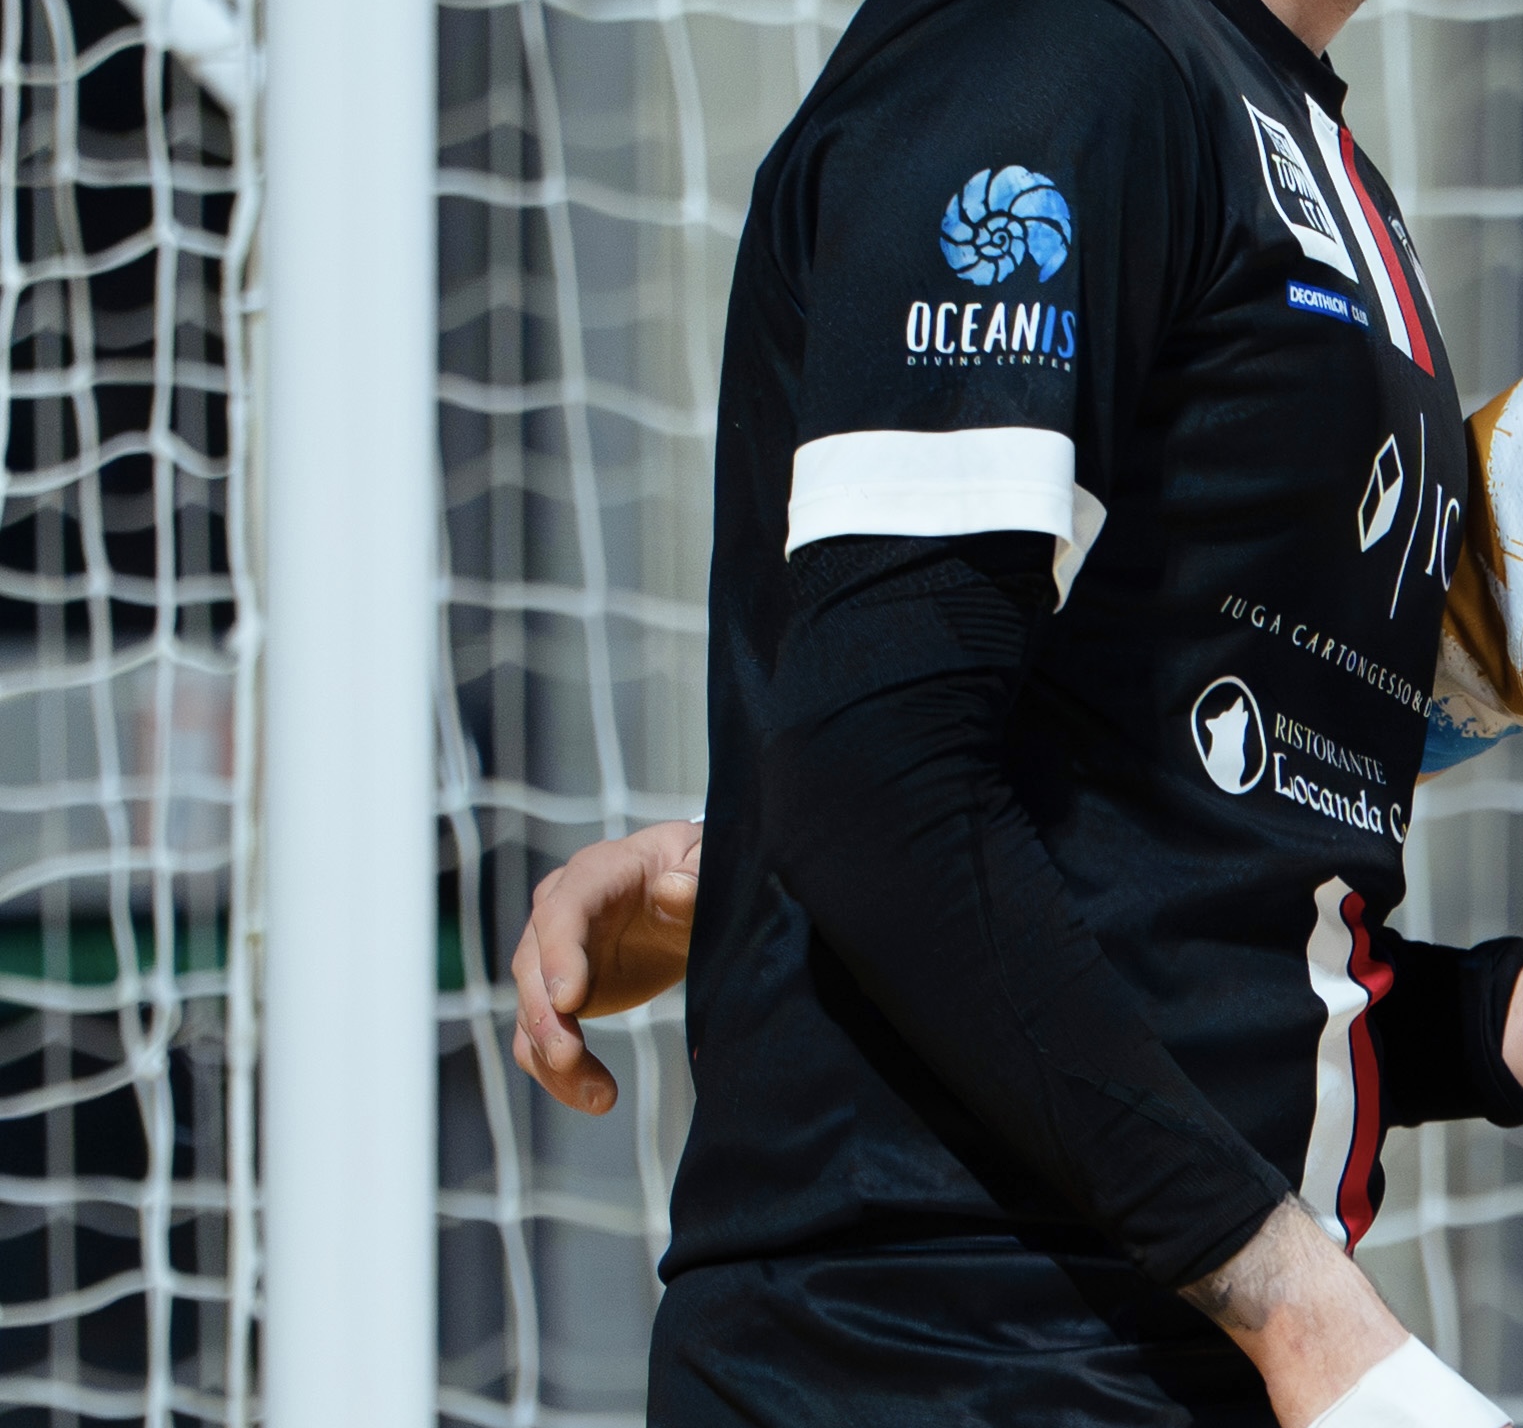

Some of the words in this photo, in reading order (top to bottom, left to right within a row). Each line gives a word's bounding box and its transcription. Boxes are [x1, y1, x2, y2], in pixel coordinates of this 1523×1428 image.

[906, 301, 1076, 359] OCEANIS
[1289, 285, 1348, 317] DECATHLON
[906, 355, 982, 368] DIVING
[996, 355, 1072, 373] CENTER
[1220, 595, 1281, 635] IUGA
[1292, 624, 1411, 705] CARTONGESSO
[1275, 712, 1387, 785] RISTORANTE
[1273, 752, 1384, 835] Locanda
